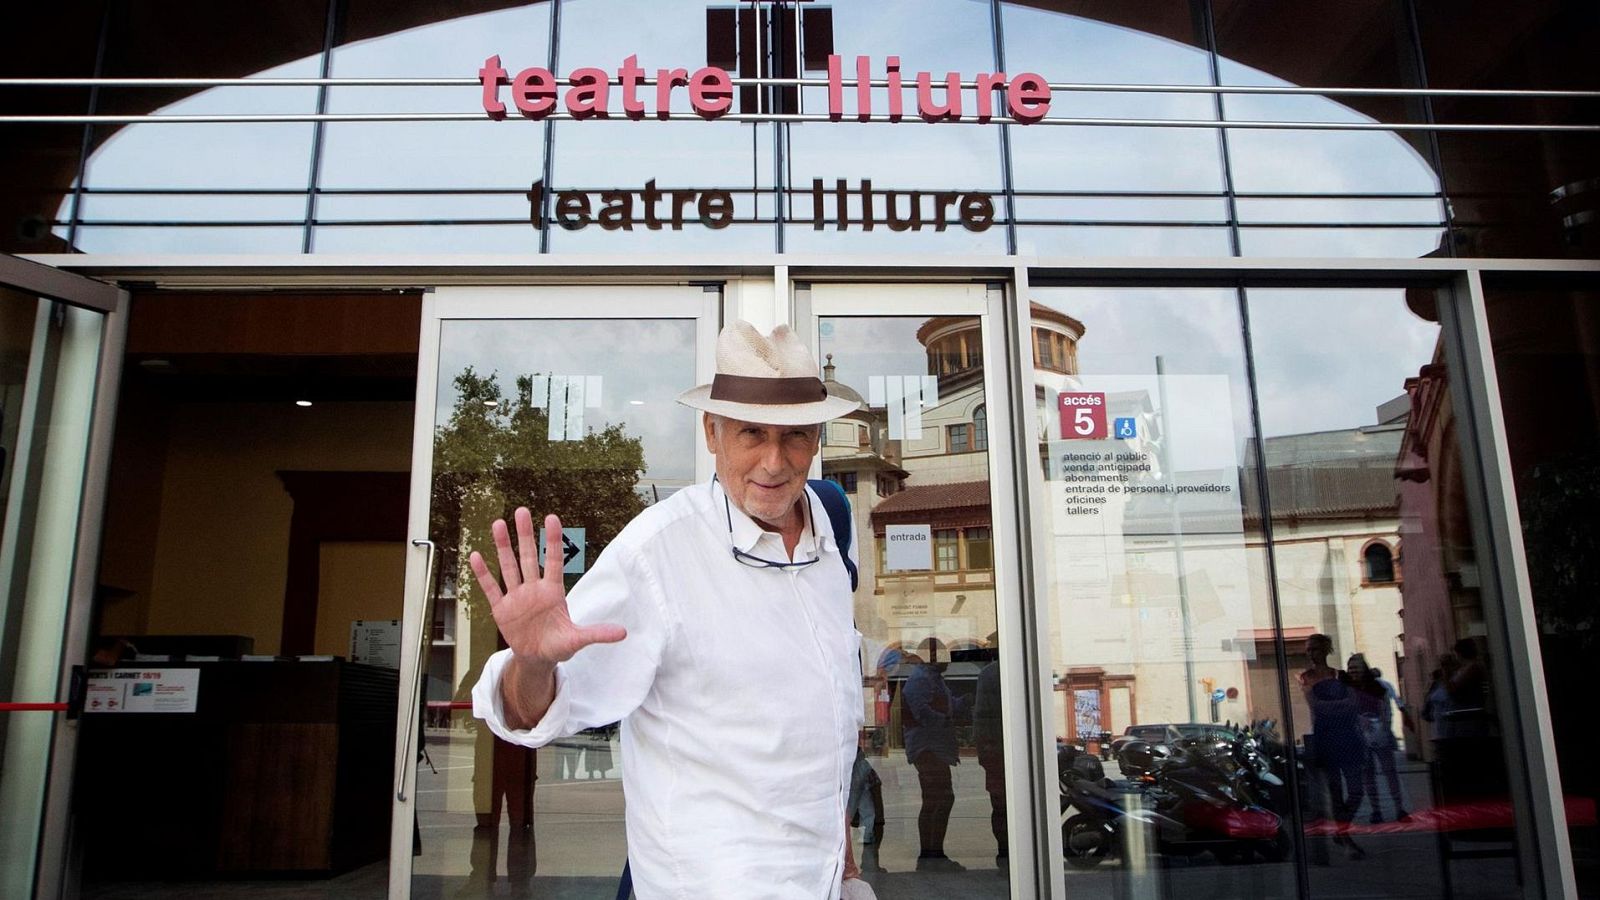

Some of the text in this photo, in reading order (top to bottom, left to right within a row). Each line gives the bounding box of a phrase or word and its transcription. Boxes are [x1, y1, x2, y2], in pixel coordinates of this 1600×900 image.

[479, 54, 1052, 125] teatre lliure
[526, 177, 734, 231] teatre
[1063, 396, 1102, 406] accés
[1074, 408, 1094, 435] 5
[1063, 452, 1147, 464] atenció al públic
[1064, 462, 1151, 474] venda anticipada
[1065, 474, 1129, 482] abonaments
[1065, 484, 1105, 493] entrada
[1108, 484, 1121, 493] de
[1123, 484, 1168, 496] personal
[1176, 484, 1231, 495] proveïdors
[1066, 494, 1107, 504] oficines
[1067, 506, 1099, 515] tallers
[890, 532, 926, 541] entrada
